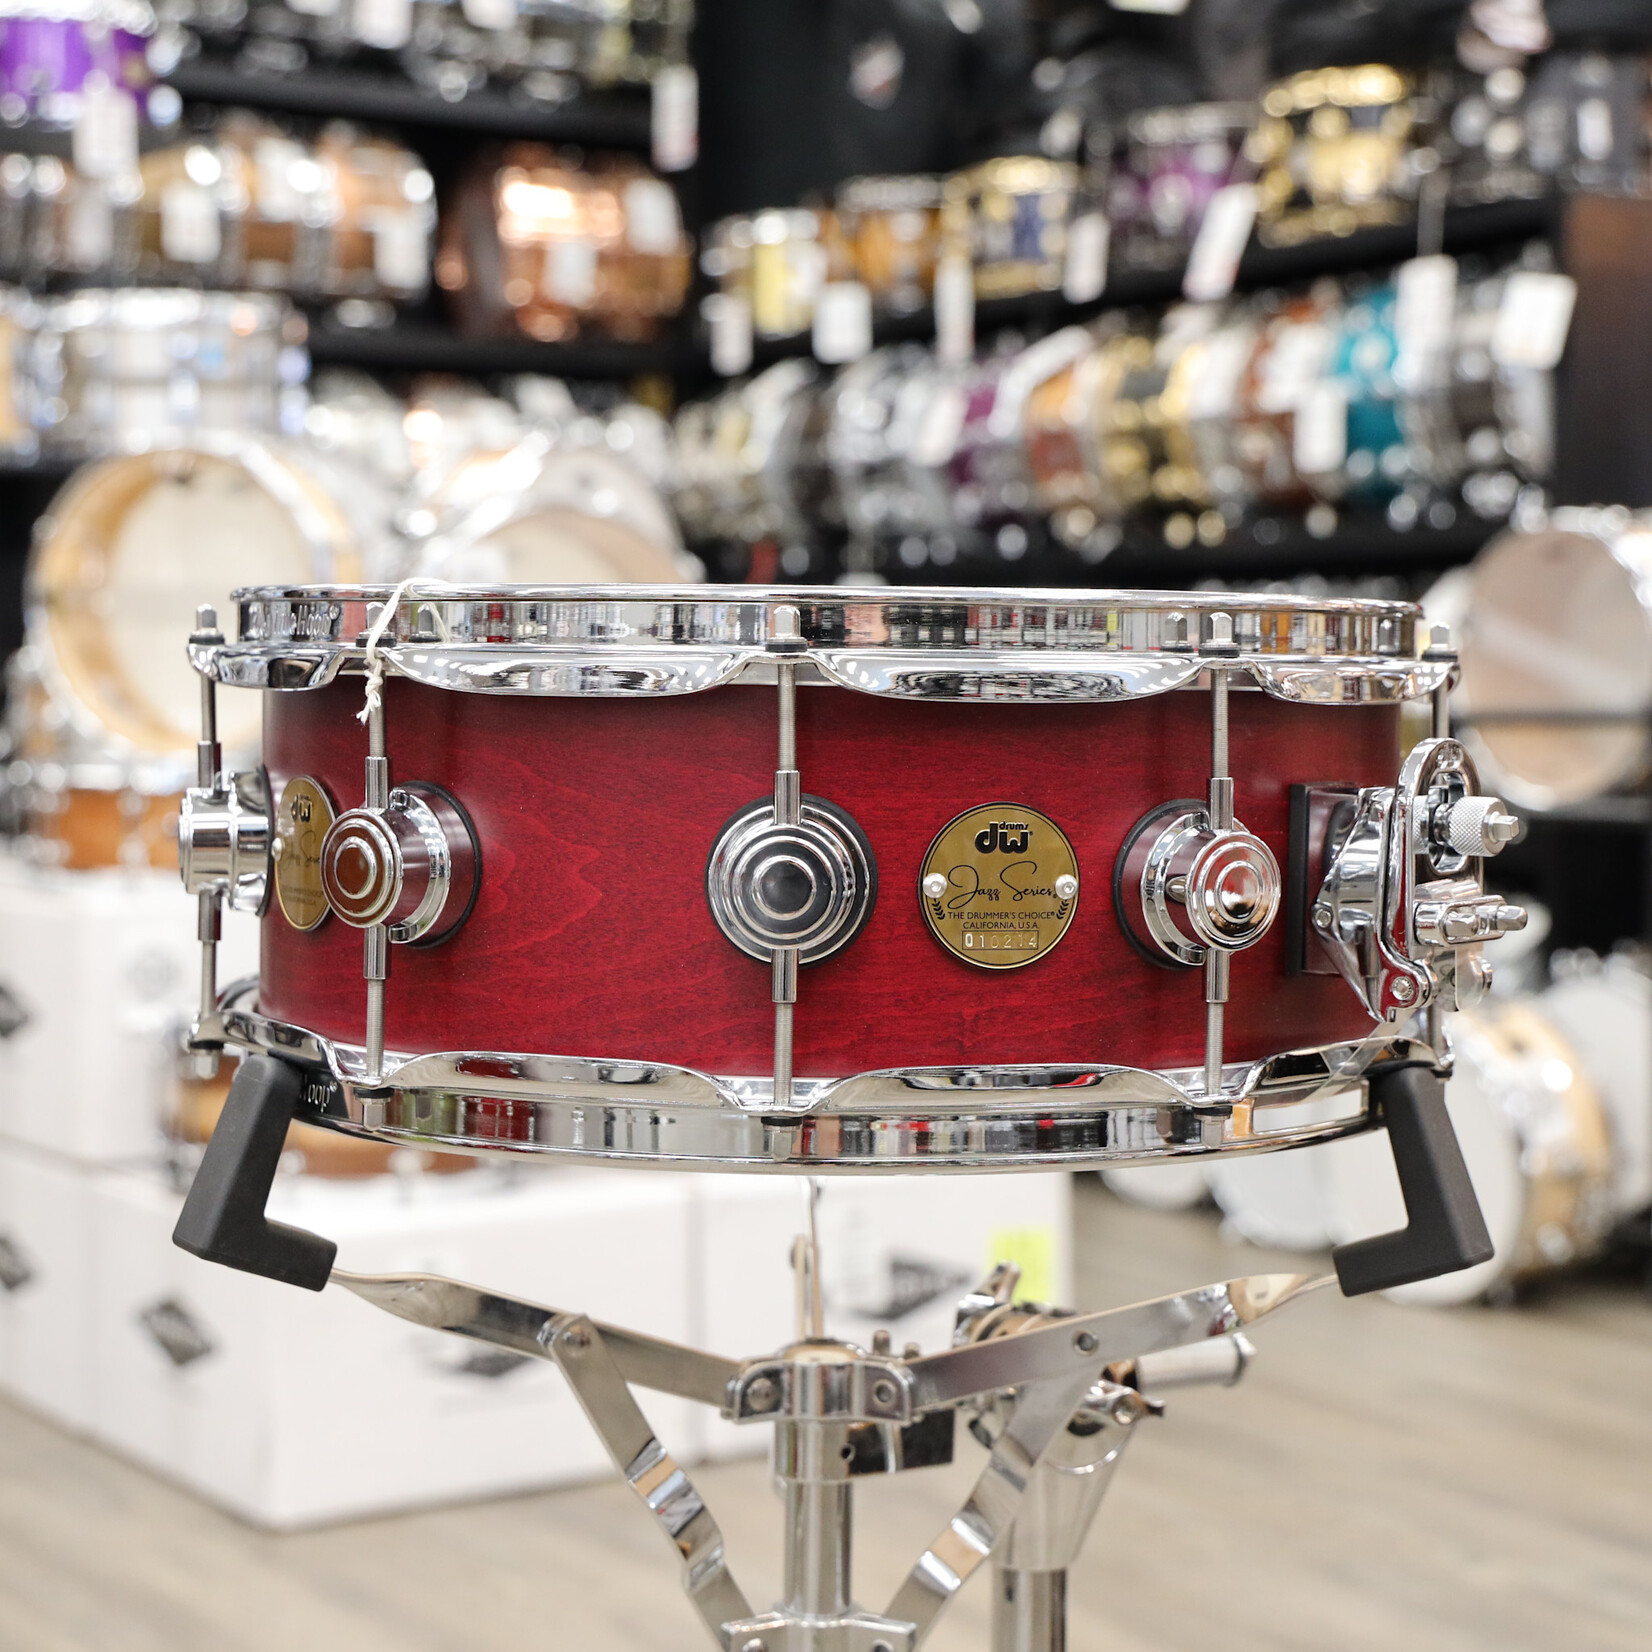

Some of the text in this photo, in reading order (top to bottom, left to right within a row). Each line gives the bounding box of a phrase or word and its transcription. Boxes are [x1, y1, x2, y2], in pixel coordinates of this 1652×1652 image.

[999, 821, 1029, 830] drums
[975, 822, 1029, 854] dw
[947, 861, 1053, 909] Jazz Series
[948, 911, 964, 920] THE
[967, 911, 1016, 920] DRUMMER'S
[963, 921, 1017, 930] CALIFORNIA,
